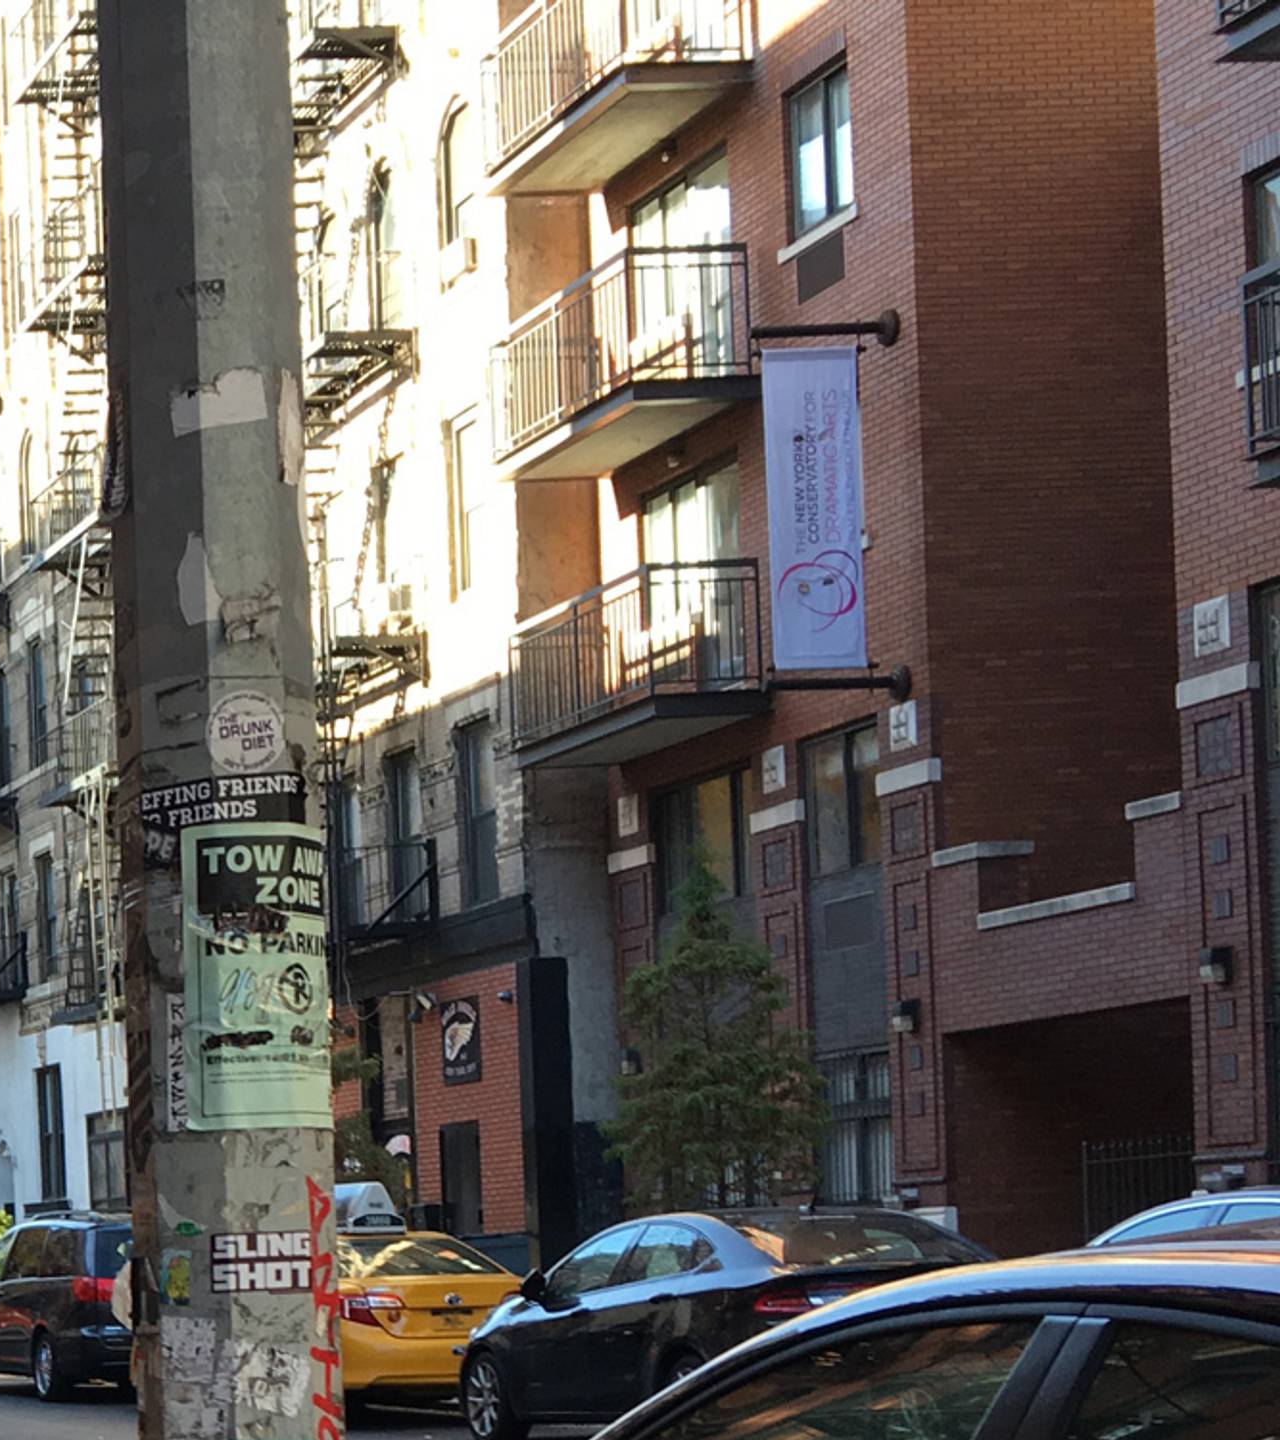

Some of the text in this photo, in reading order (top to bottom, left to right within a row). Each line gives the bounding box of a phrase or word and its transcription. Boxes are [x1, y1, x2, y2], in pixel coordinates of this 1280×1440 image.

[804, 391, 820, 545] CONSERVATORY FOR
[822, 388, 842, 544] DRAMATIC ARTS
[794, 444, 808, 554] THE NEW YORK
[219, 714, 238, 725] THE
[219, 719, 274, 740] DRUNK
[241, 734, 274, 751] DIET
[141, 782, 211, 811] EFFING
[168, 799, 258, 827] FRIENDS
[202, 845, 285, 875] TOW
[256, 877, 321, 905] ZONE
[205, 927, 250, 956] NO
[212, 1232, 311, 1259] SLING
[212, 1260, 312, 1292] SHOT
